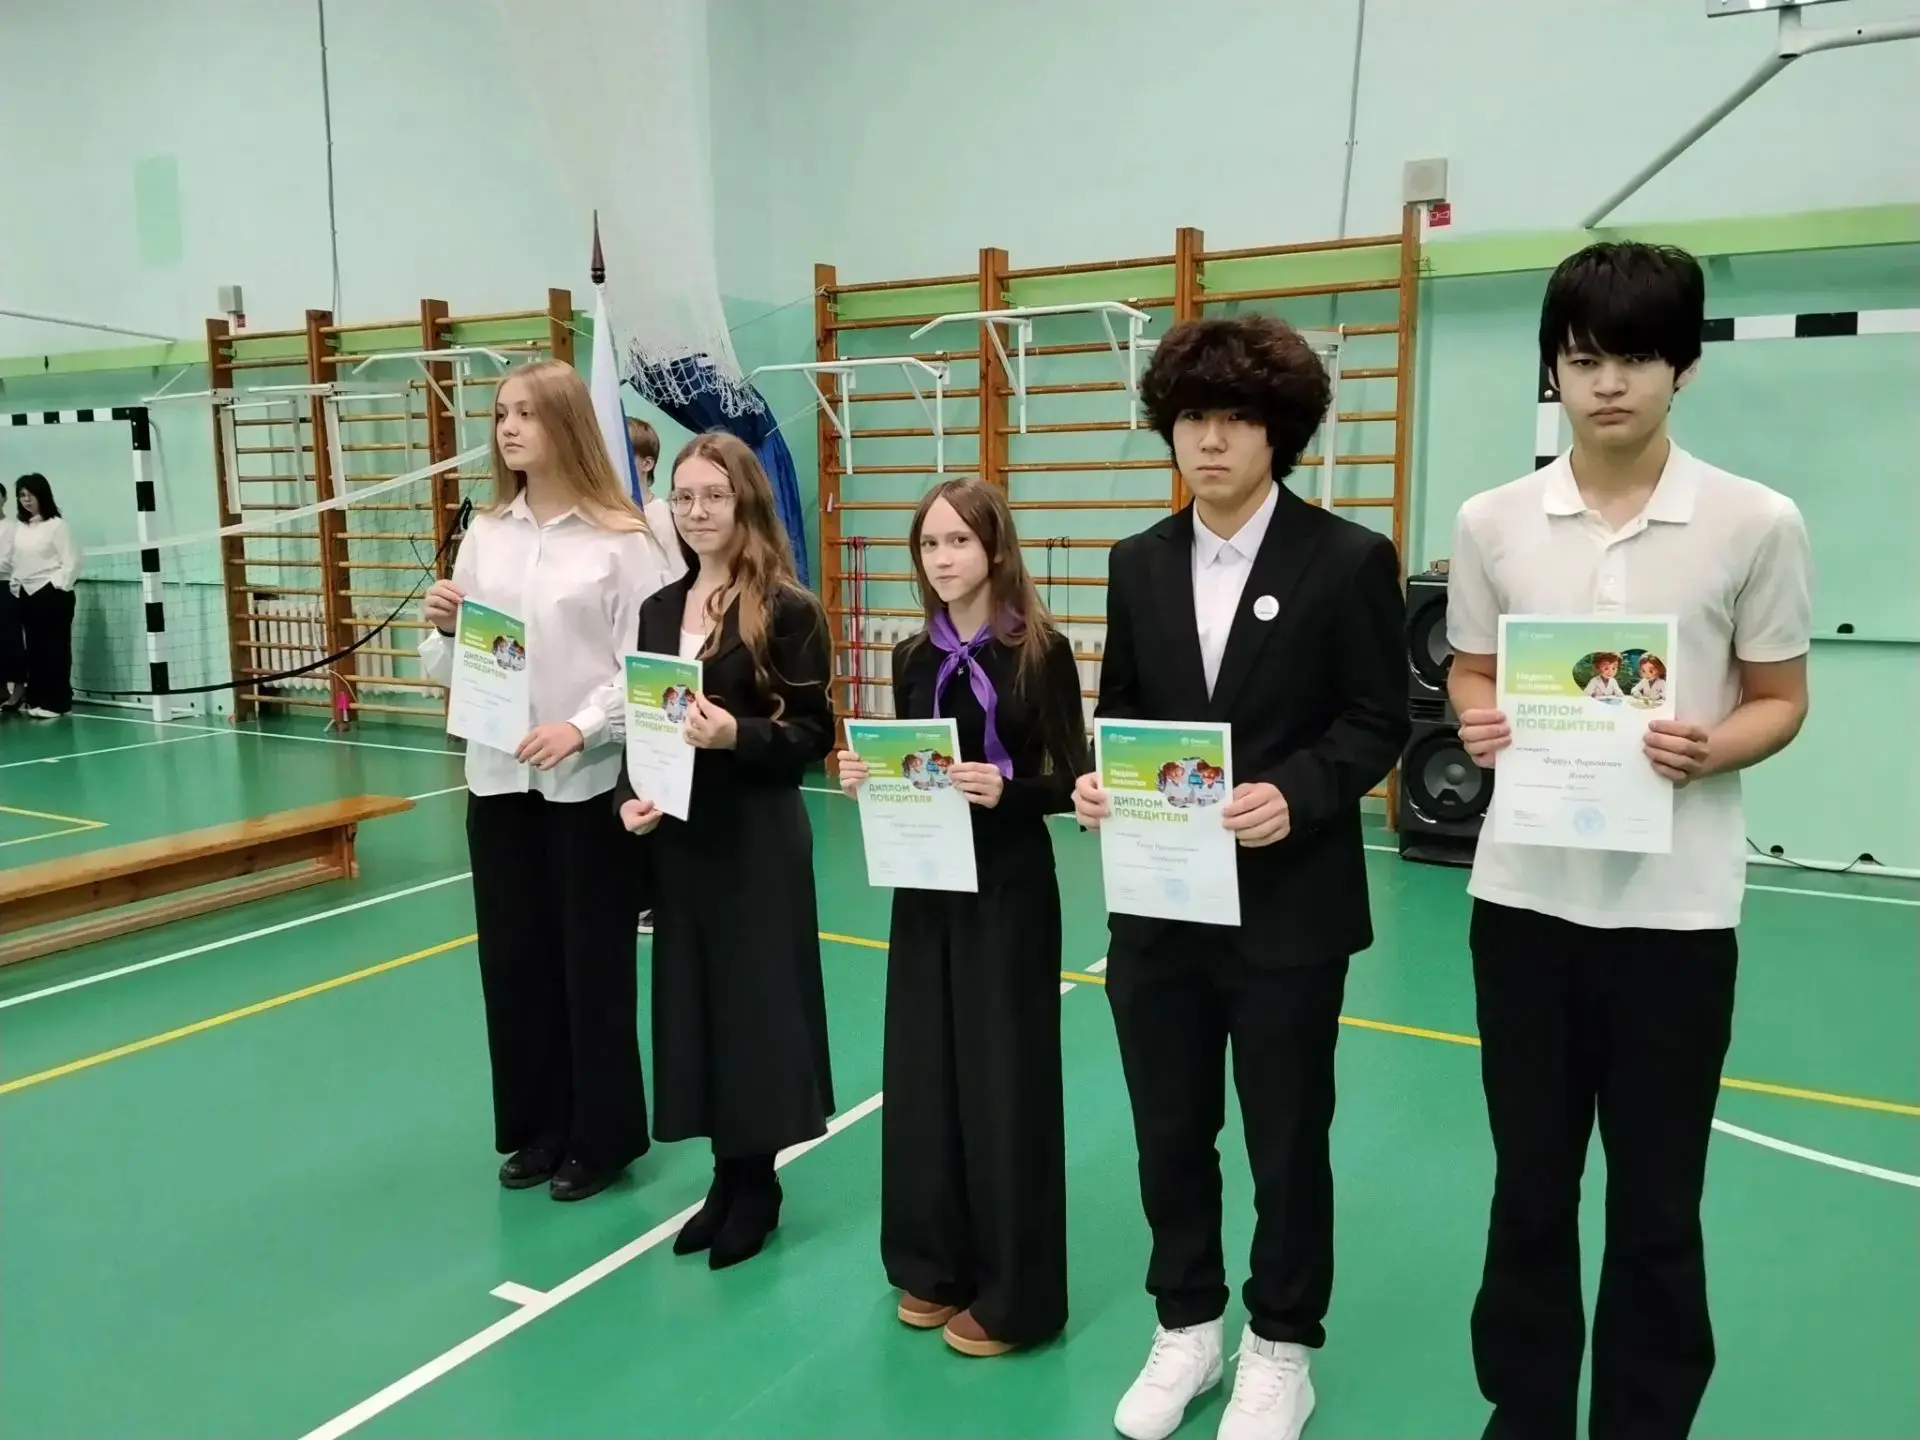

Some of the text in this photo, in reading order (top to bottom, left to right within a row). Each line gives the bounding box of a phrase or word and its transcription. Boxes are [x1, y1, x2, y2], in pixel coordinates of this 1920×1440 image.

[1516, 702, 1584, 717] ДИПЛОМ
[1516, 718, 1616, 733] ПОБЕДИТЕЛЯ
[1113, 795, 1163, 809] ДИПЛОМ
[1114, 808, 1189, 822] ПОБЕДИТЕЛЯ
